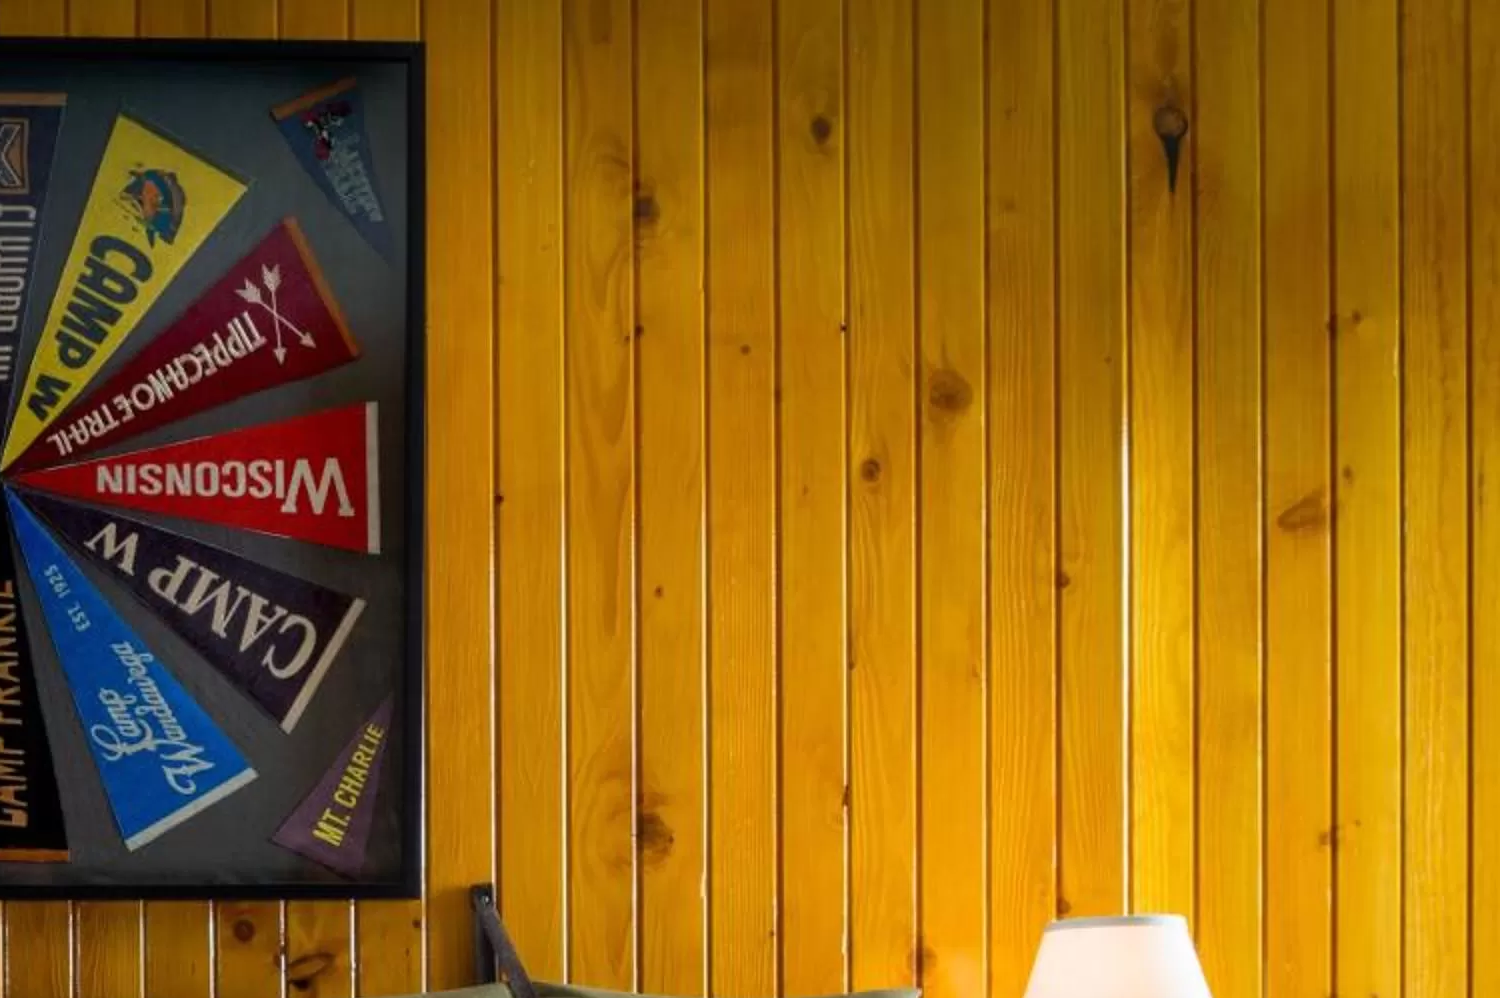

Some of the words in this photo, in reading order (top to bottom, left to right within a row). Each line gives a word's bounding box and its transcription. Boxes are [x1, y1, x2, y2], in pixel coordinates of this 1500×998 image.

[53, 234, 154, 370] CAMP
[25, 373, 73, 423] W
[112, 310, 268, 424] TIPPECANOE
[46, 403, 121, 457] TRAIL
[96, 456, 356, 517] WISCONSIN
[43, 563, 72, 599] 1925
[83, 521, 141, 577] W
[148, 553, 318, 680] CAMP
[91, 687, 158, 763] Camp
[111, 640, 216, 795] Wandawega
[311, 804, 352, 847] MT.
[333, 722, 385, 808] CHARLIE
